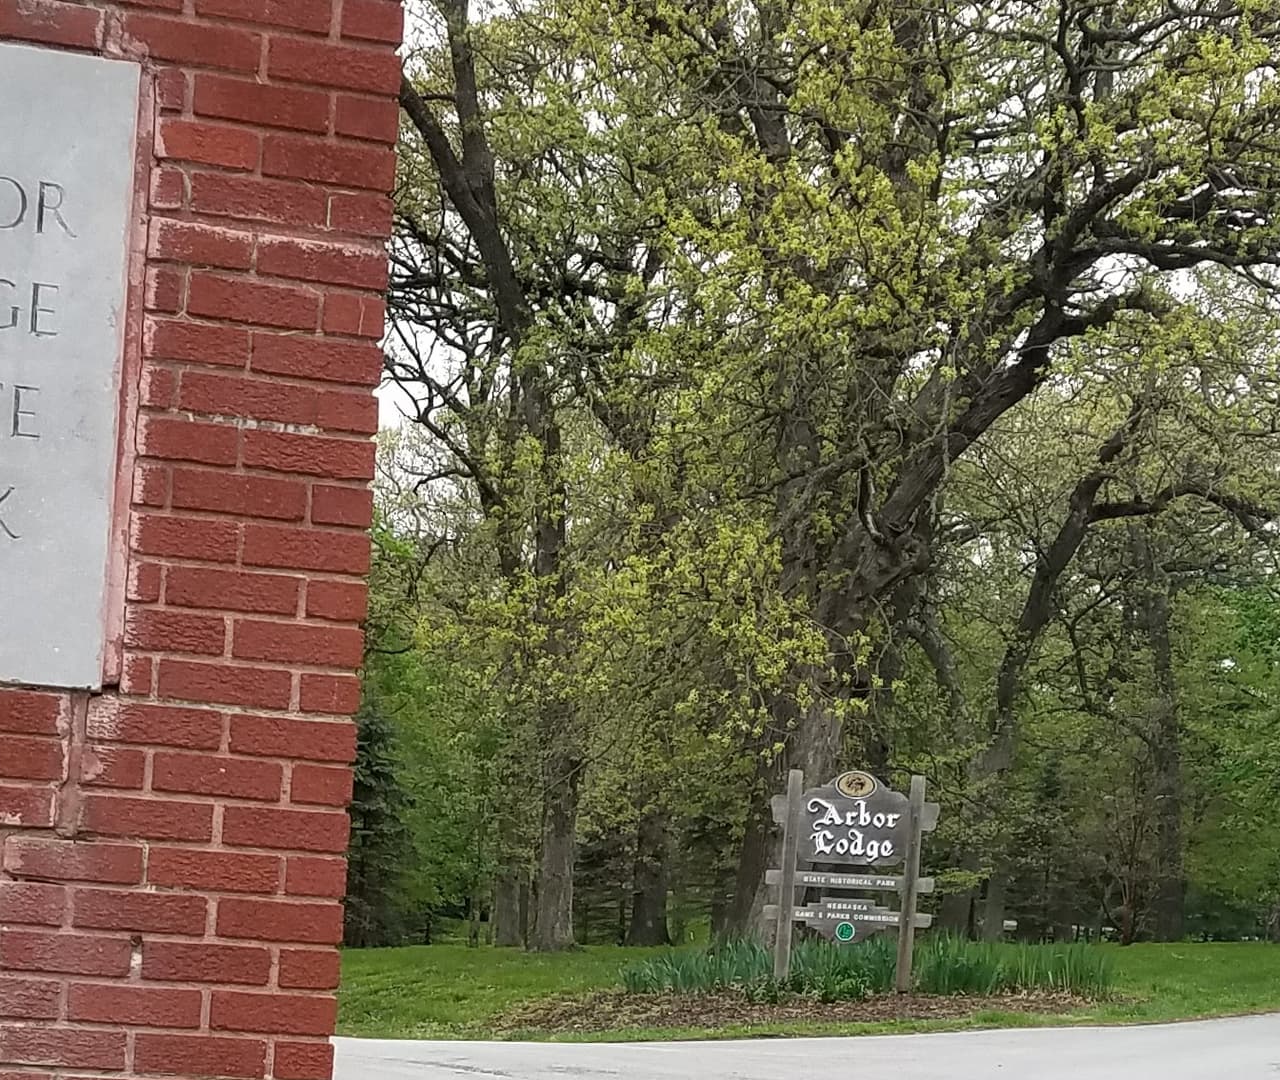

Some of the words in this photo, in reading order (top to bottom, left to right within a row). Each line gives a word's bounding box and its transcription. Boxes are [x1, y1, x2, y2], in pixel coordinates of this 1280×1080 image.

[807, 798, 901, 831] Arbor
[809, 829, 895, 863] Lodge
[803, 875, 827, 884] STATE
[830, 877, 873, 886] HISTORICAL
[875, 879, 896, 887] PARK
[826, 902, 868, 911] NEBRASKA
[794, 910, 815, 918] GAME
[826, 912, 850, 920] PARKS
[853, 914, 900, 922] COMMISSION
